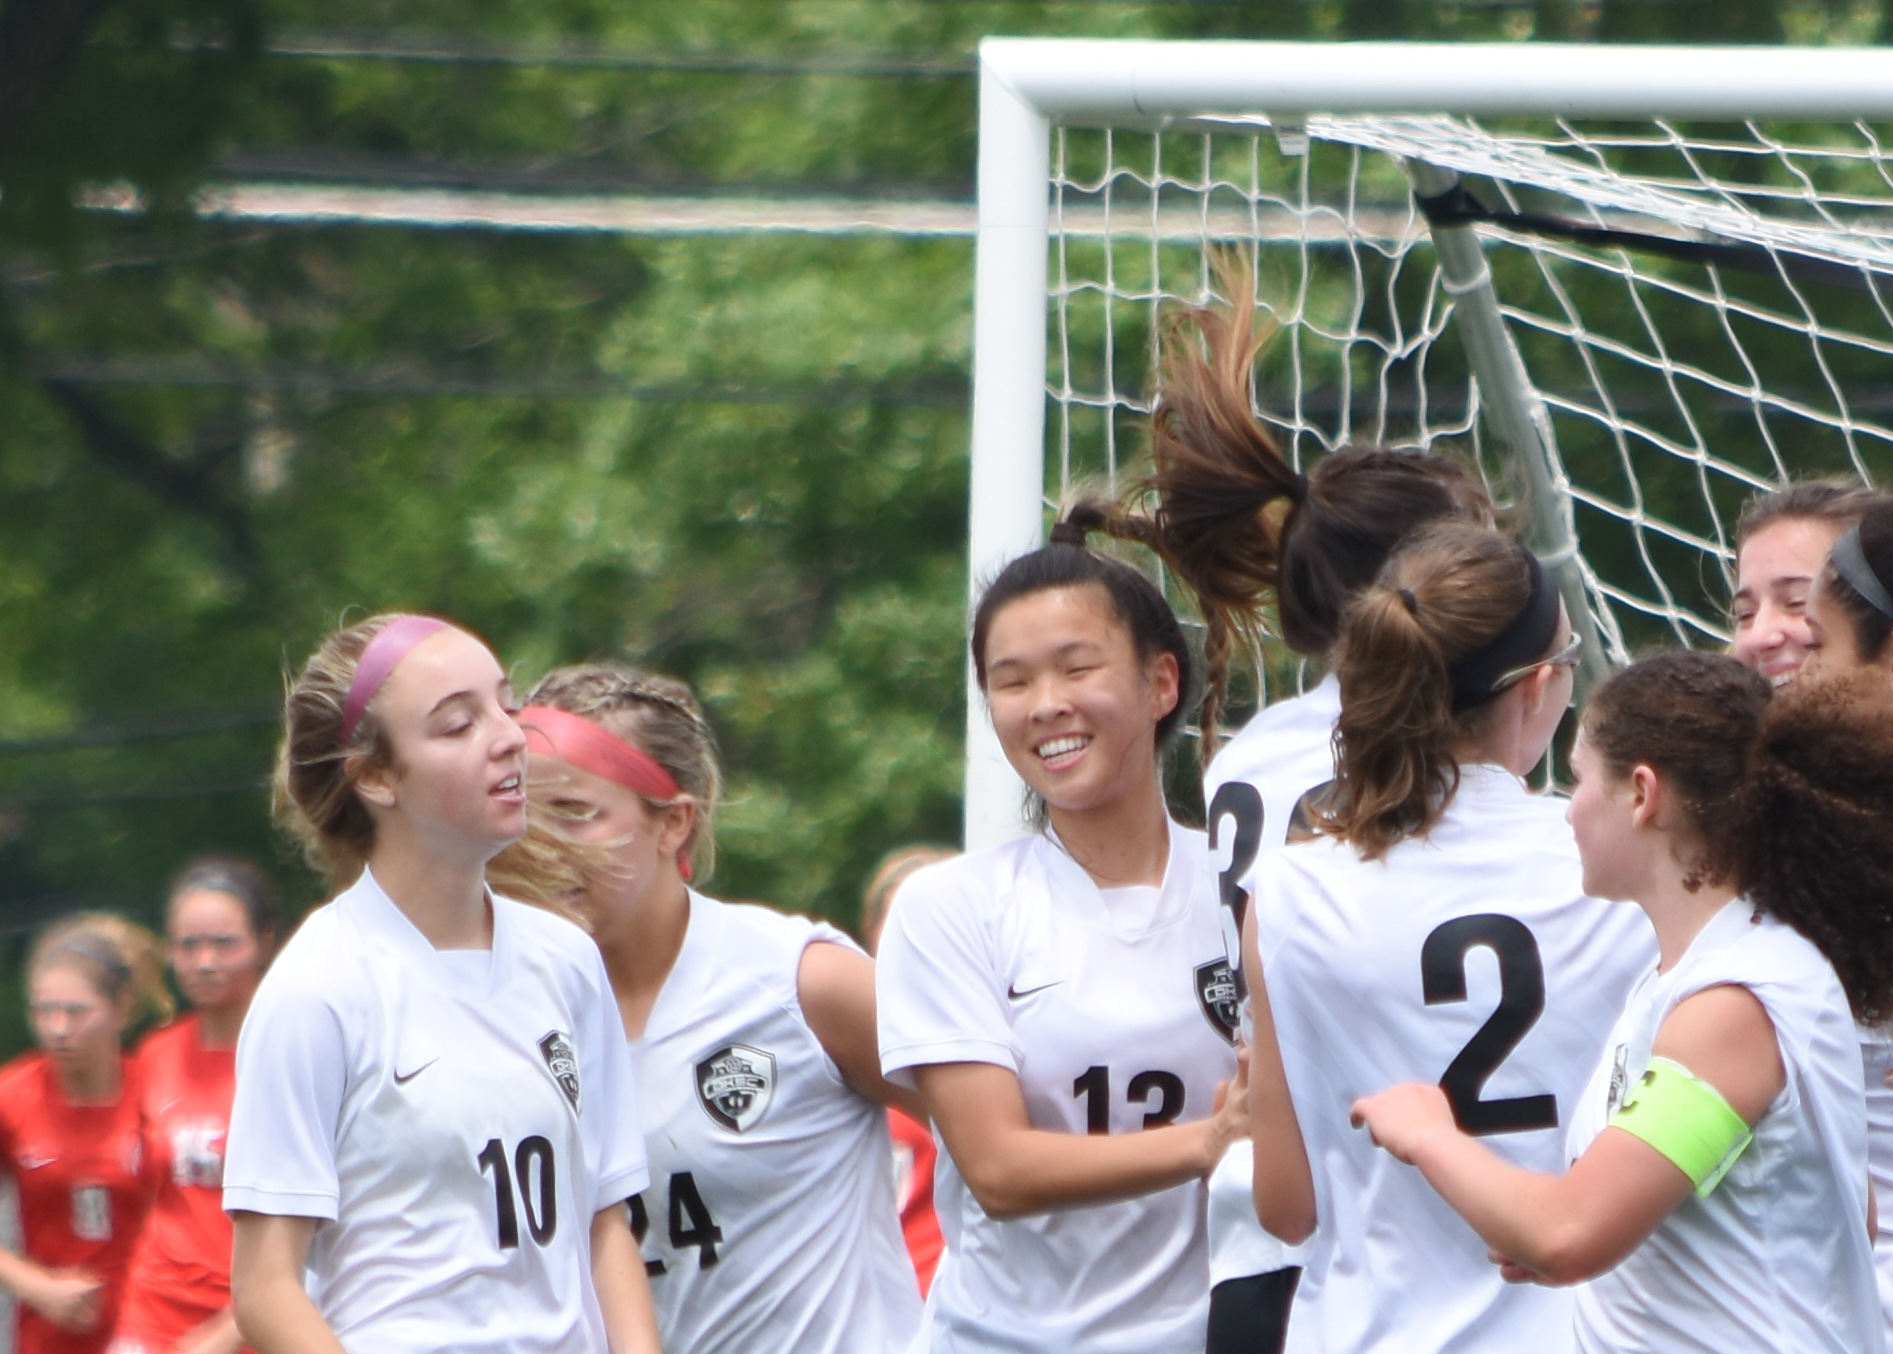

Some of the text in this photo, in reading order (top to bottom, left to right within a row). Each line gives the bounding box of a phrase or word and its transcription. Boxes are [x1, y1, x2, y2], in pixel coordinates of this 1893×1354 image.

[1421, 913, 1559, 1137] 2
[1073, 1066, 1185, 1136] 13
[477, 1135, 557, 1250] 10
